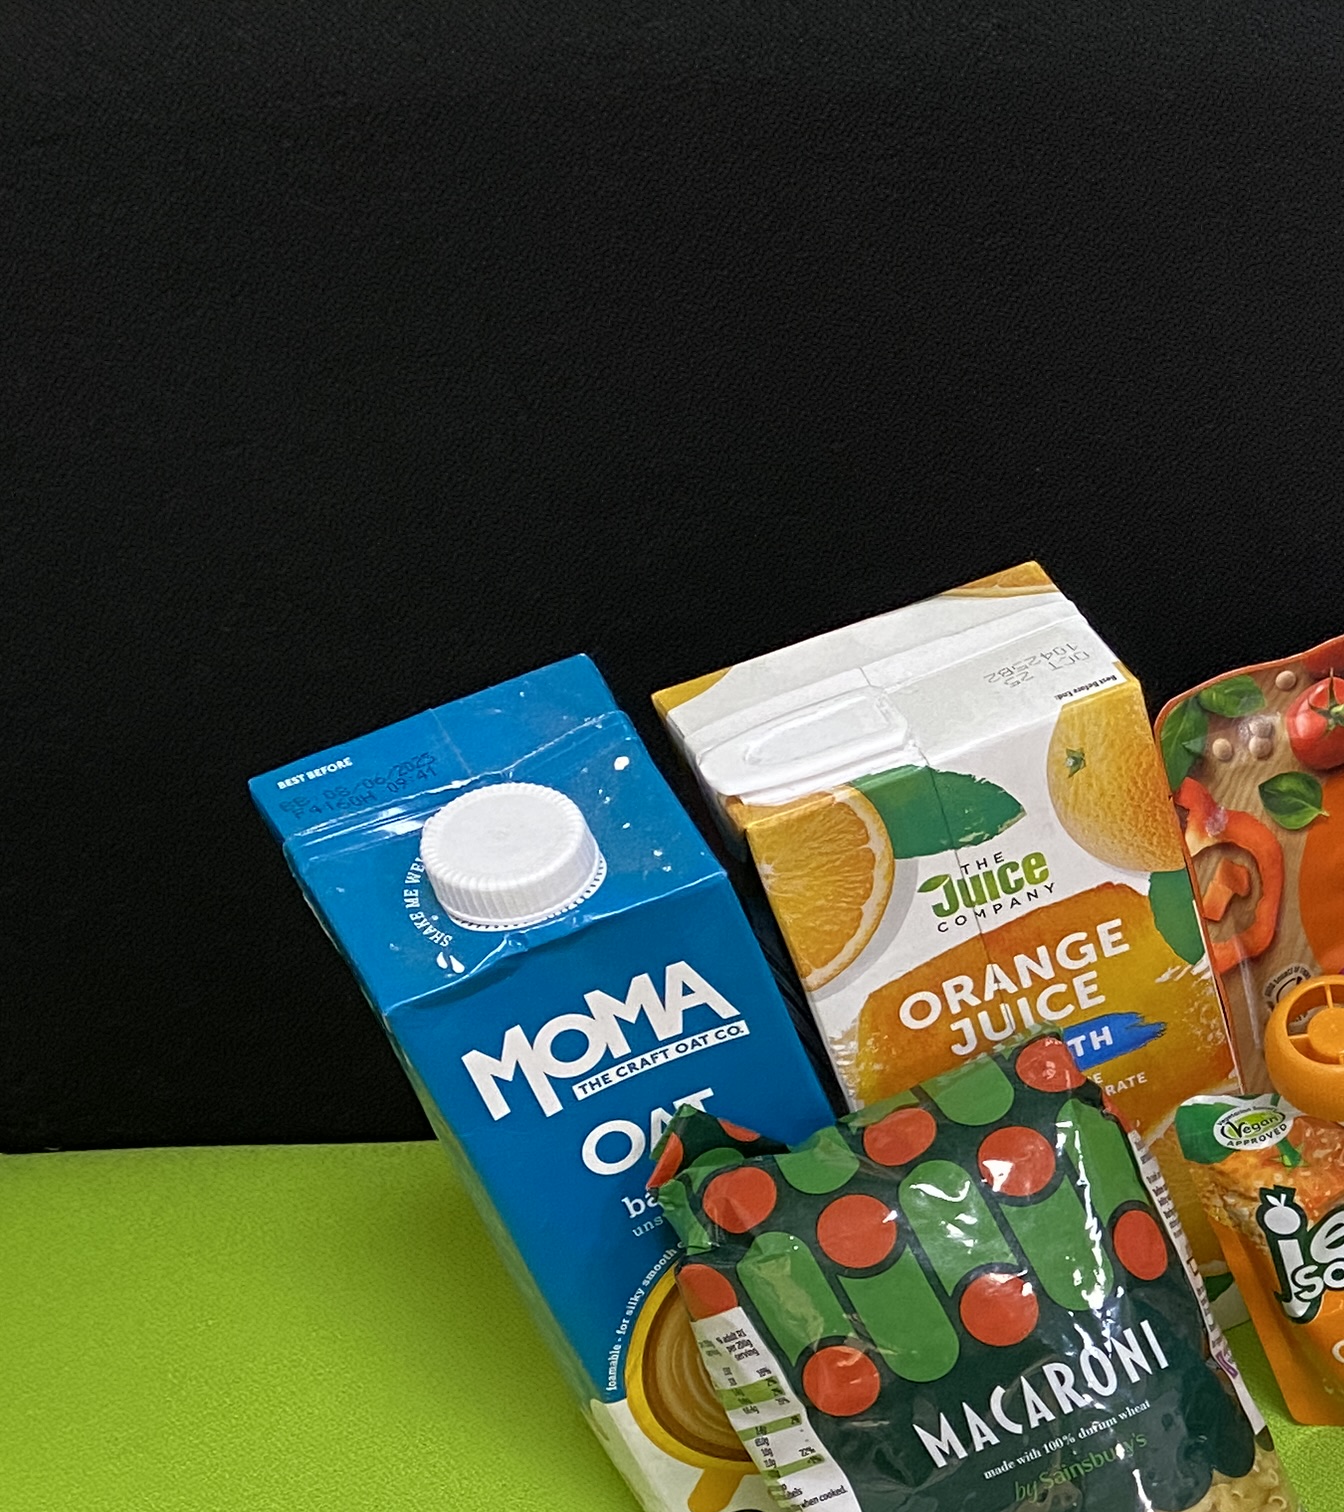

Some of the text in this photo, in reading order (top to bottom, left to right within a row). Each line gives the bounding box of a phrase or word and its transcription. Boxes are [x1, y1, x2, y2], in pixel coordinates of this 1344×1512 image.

[277, 757, 353, 790] BEST BEFORE
[931, 851, 1051, 918] Juice
[960, 852, 1006, 875] THE
[403, 889, 453, 947] SHAKE ME
[937, 881, 1056, 933] COMPANY
[899, 918, 1130, 1031] ORANGE
[461, 961, 741, 1121] MOMA
[950, 971, 1106, 1056] JUICE
[577, 1034, 710, 1097] THE CRAFT OAT
[1226, 1122, 1288, 1149] APPROVED
[913, 1320, 1169, 1468] MACARONI
[983, 1399, 1151, 1481] made with 100% durum wheat
